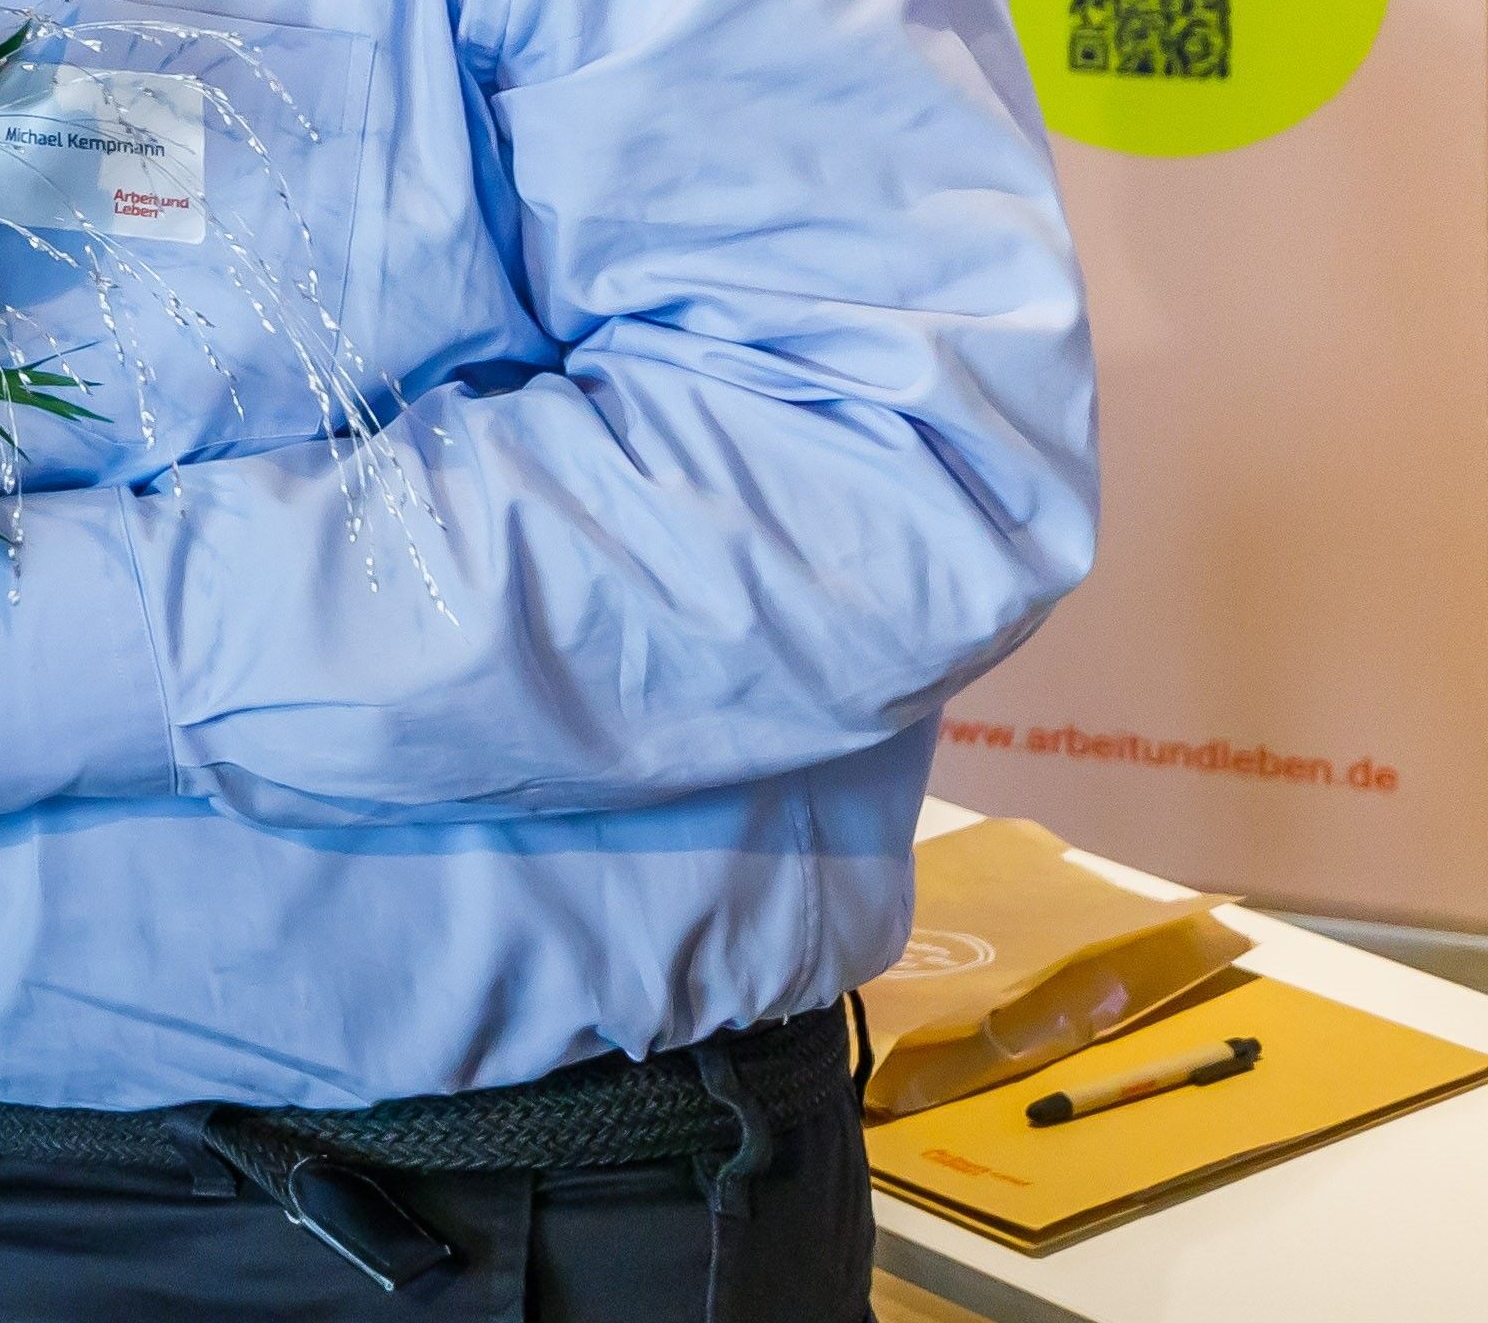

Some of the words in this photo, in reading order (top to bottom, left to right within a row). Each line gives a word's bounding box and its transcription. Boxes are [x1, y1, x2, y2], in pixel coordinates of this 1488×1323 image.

[5, 127, 64, 149] Michael
[68, 133, 166, 157] Kempmann
[114, 188, 159, 205] Arbeit
[161, 197, 190, 210] und
[114, 201, 160, 219] Leben
